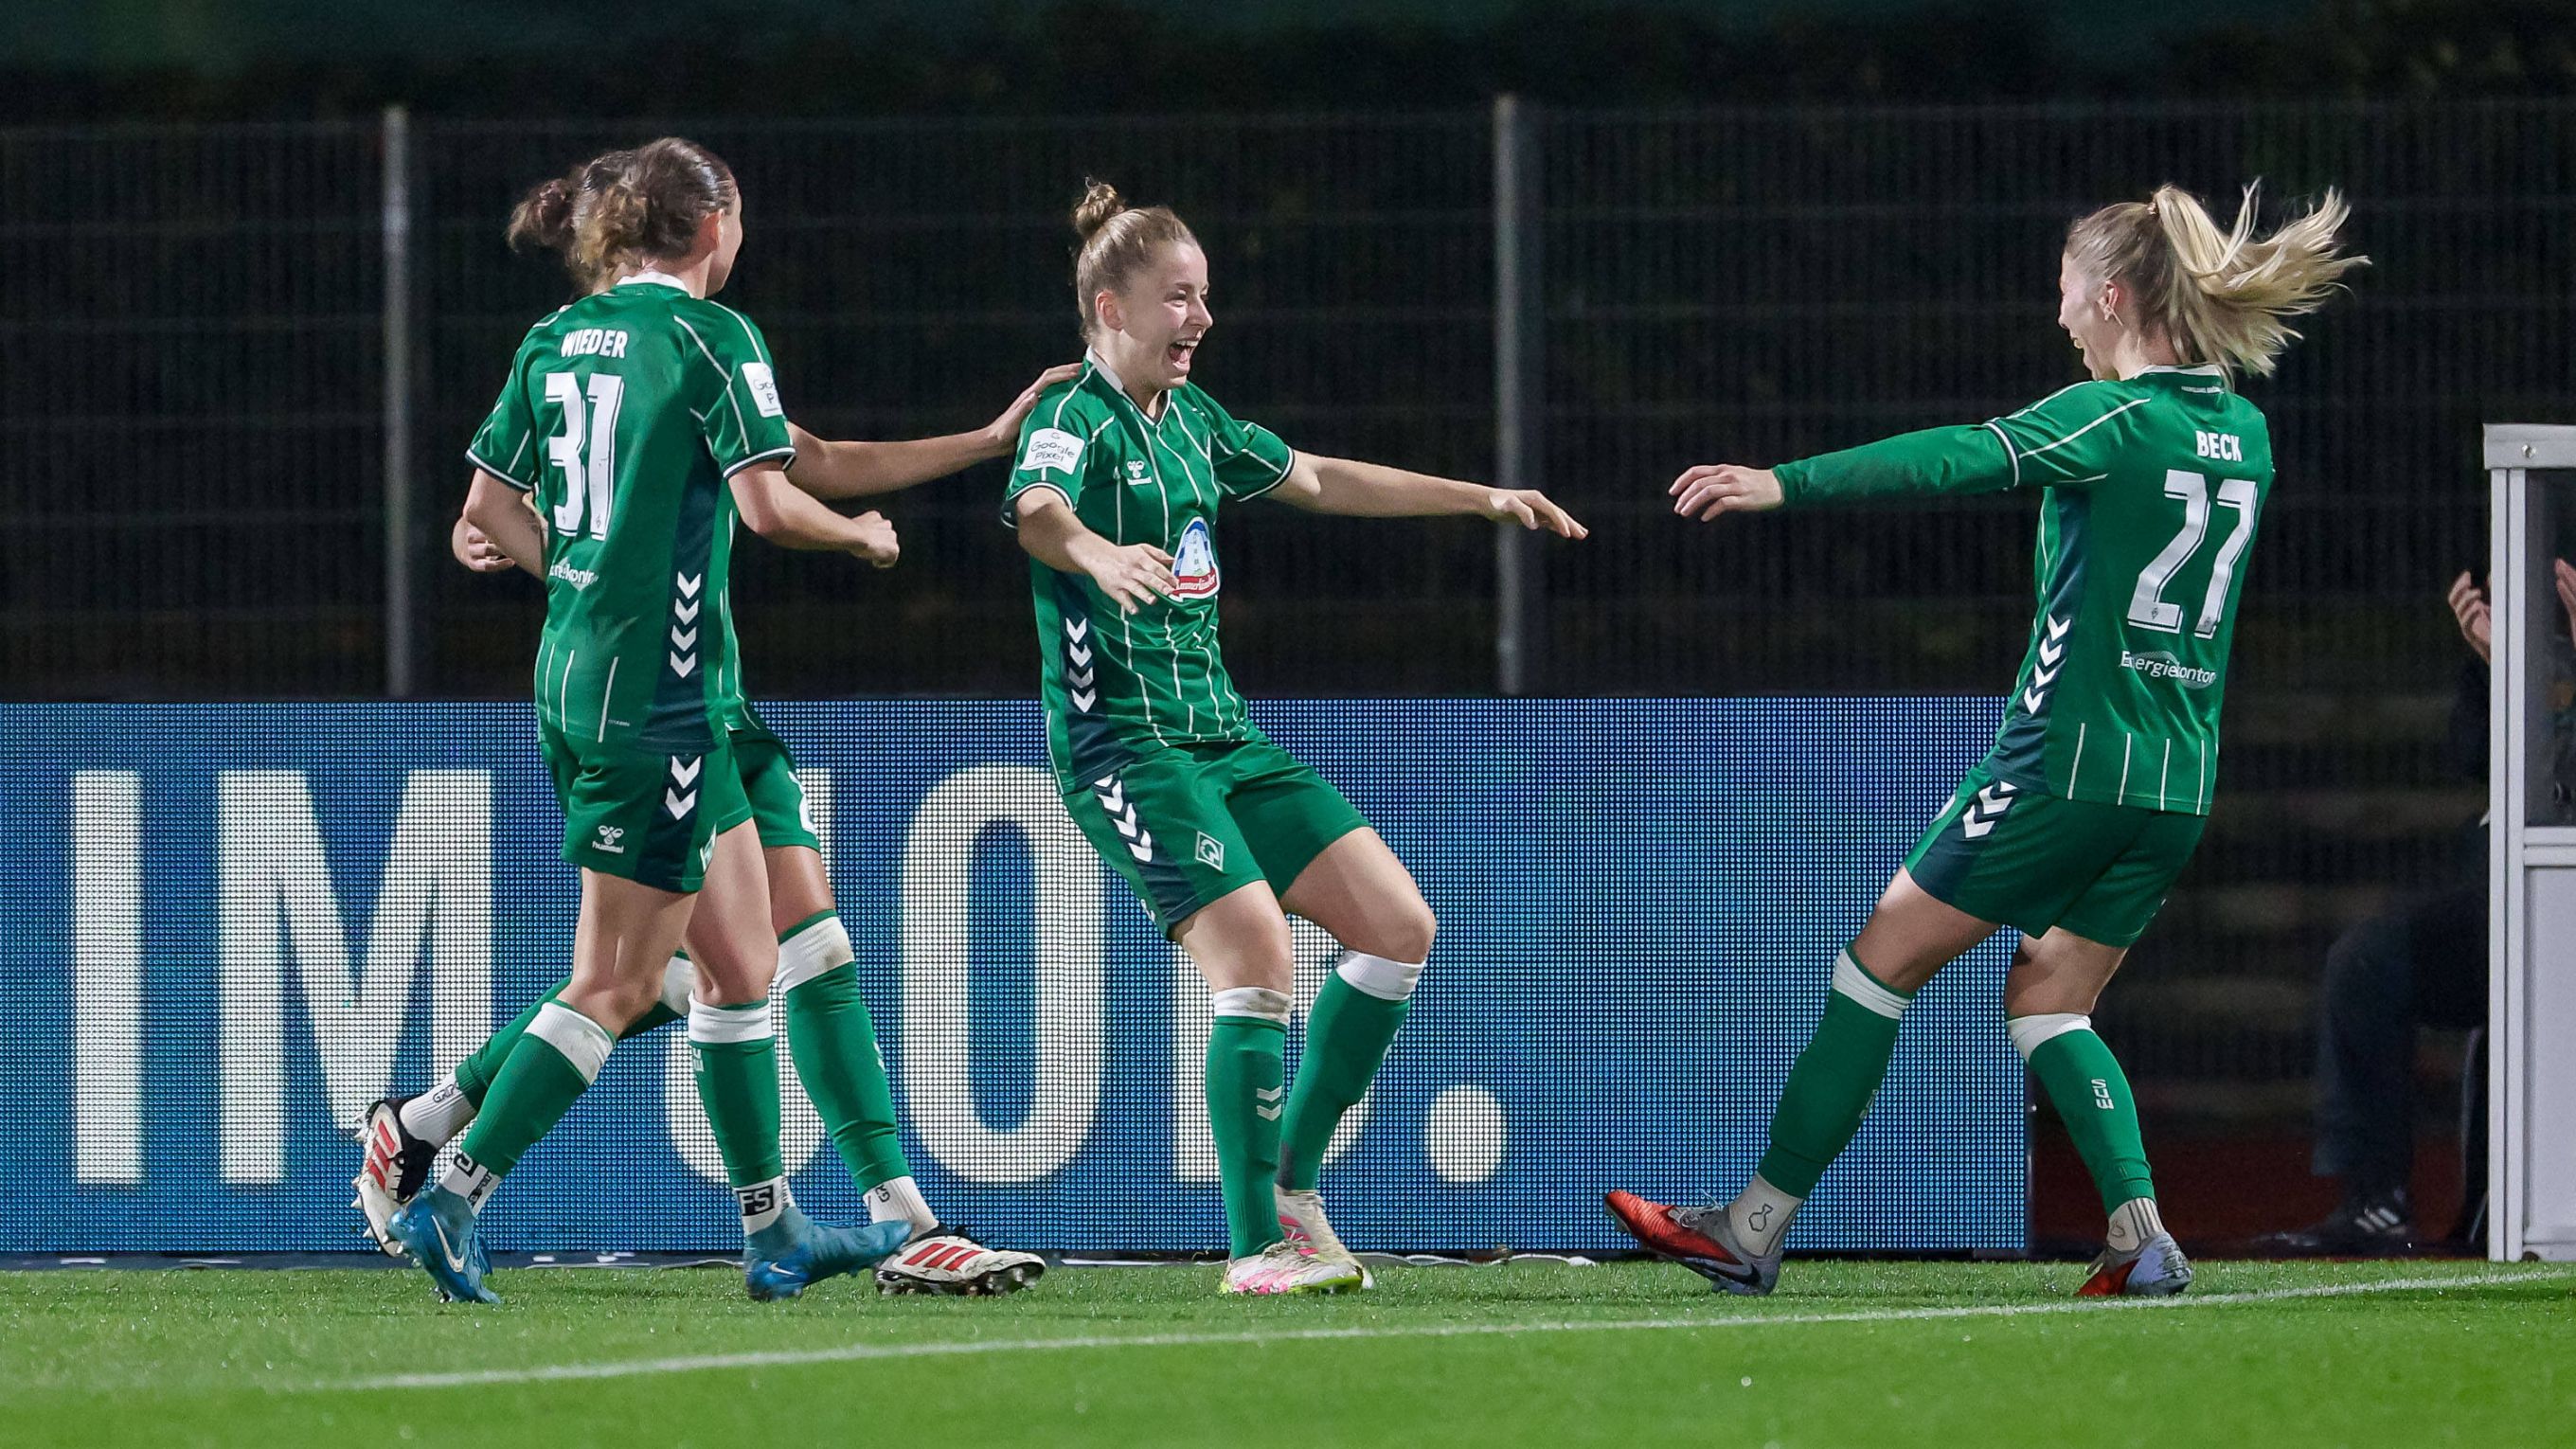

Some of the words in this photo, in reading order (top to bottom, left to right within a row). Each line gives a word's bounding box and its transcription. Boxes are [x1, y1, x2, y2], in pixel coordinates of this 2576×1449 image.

[561, 329, 628, 359] WIEDER
[546, 371, 624, 541] 31
[1030, 441, 1076, 458] Google
[2195, 430, 2243, 462] BECK
[2126, 469, 2259, 639] 27
[75, 769, 492, 1185] IM
[739, 1188, 771, 1215] FS
